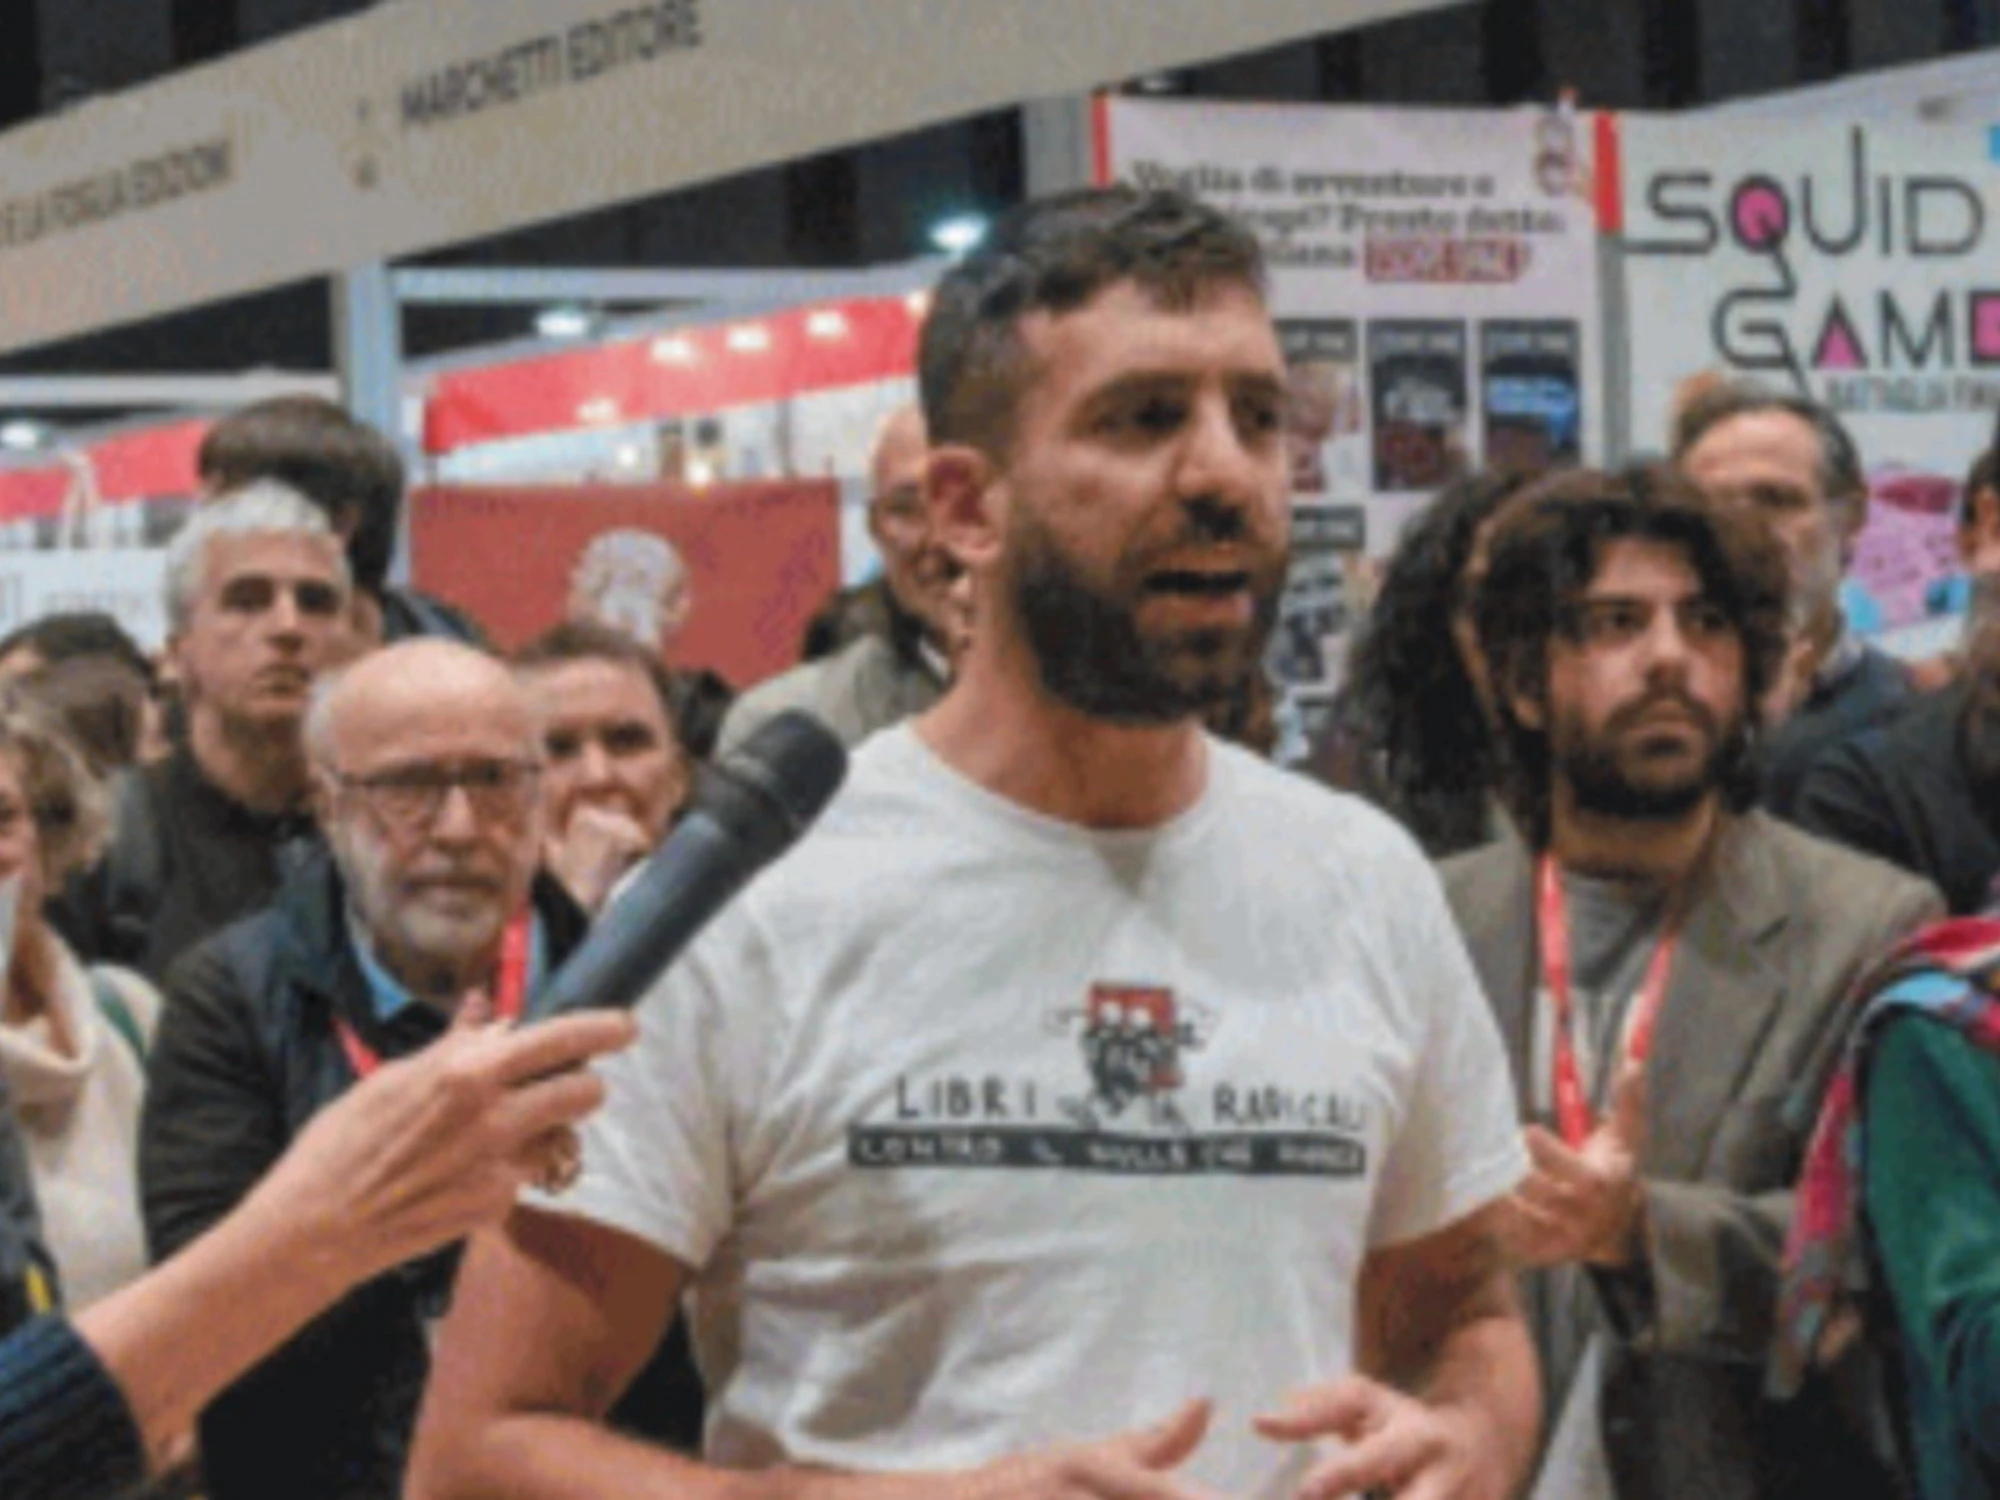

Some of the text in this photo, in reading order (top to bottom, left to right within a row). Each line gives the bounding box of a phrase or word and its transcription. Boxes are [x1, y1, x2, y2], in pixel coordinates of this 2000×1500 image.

[402, 0, 703, 126] MARCHETTI EDITORE
[1623, 124, 1986, 258] SQUID
[895, 1075, 1365, 1131] LIBRI RADICALI
